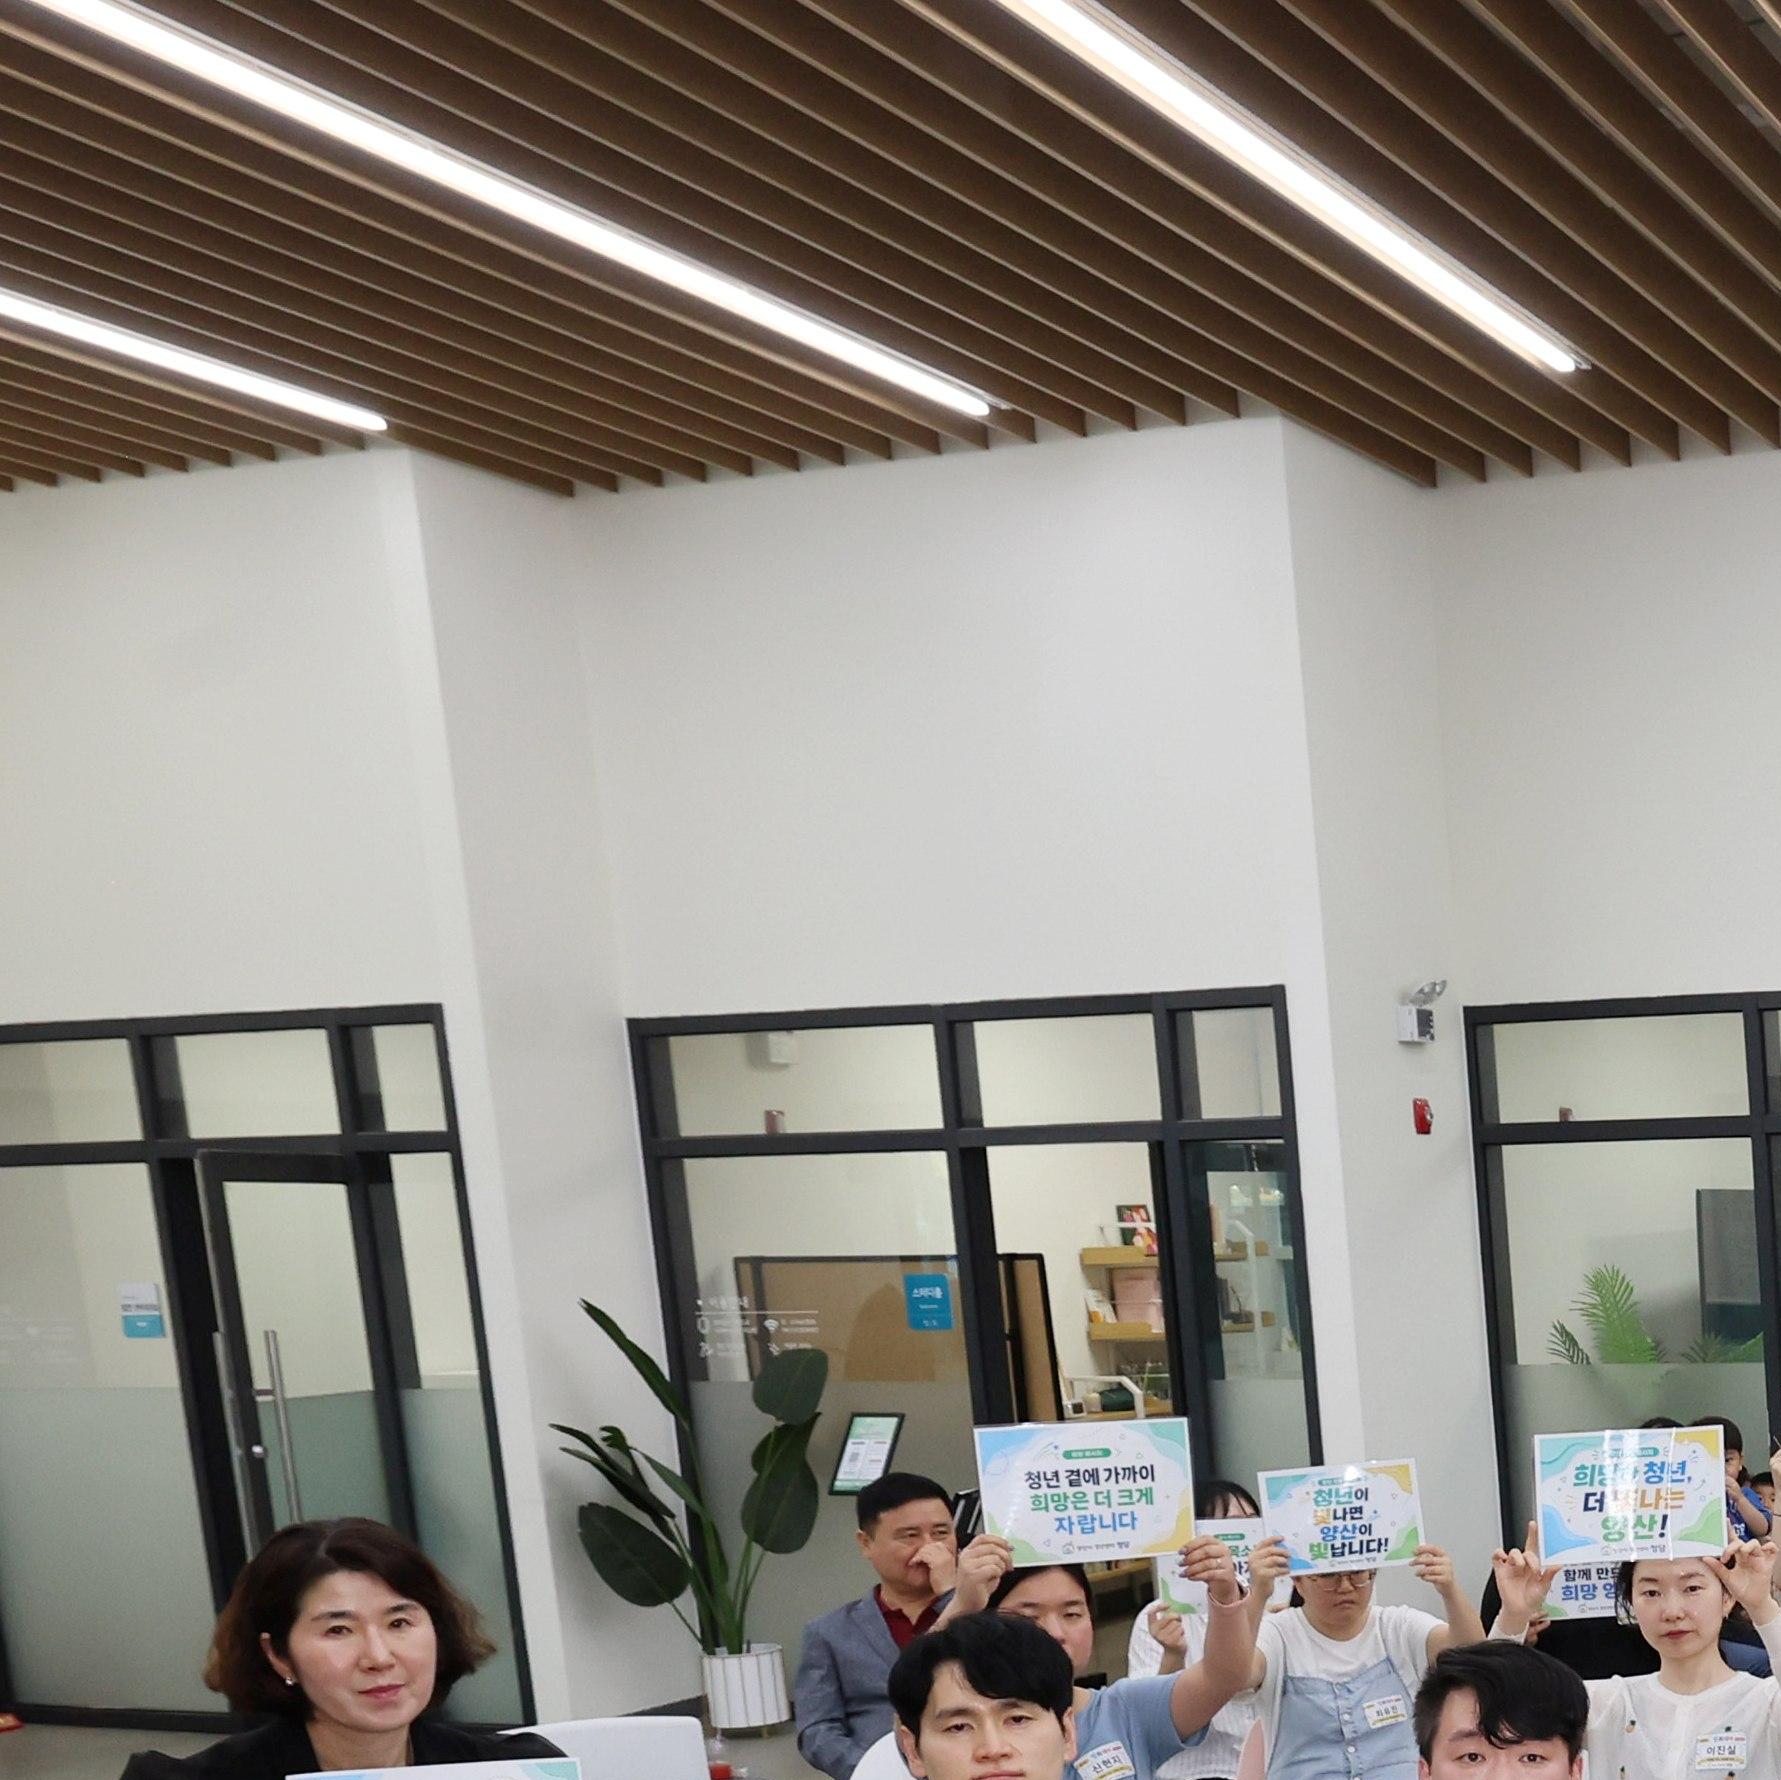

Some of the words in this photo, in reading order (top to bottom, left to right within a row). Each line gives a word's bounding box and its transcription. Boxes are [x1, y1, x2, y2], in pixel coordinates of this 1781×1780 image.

[1024, 1470, 1062, 1491] 청년
[1065, 1468, 1100, 1488] 곁에
[1102, 1464, 1155, 1485] 가까이
[1643, 1460, 1692, 1485] 청년,
[1030, 1491, 1097, 1514] 희망은
[1100, 1490, 1113, 1509] 더
[1117, 1487, 1155, 1507] 크게
[1314, 1488, 1368, 1506] 청년이
[1583, 1492, 1605, 1512] 더
[1055, 1511, 1139, 1534] 자랍니다
[1320, 1523, 1372, 1542] 양산이
[1602, 1514, 1668, 1542] 양산!
[1564, 1569, 1592, 1582] 함께
[1562, 1583, 1598, 1601] 희망
